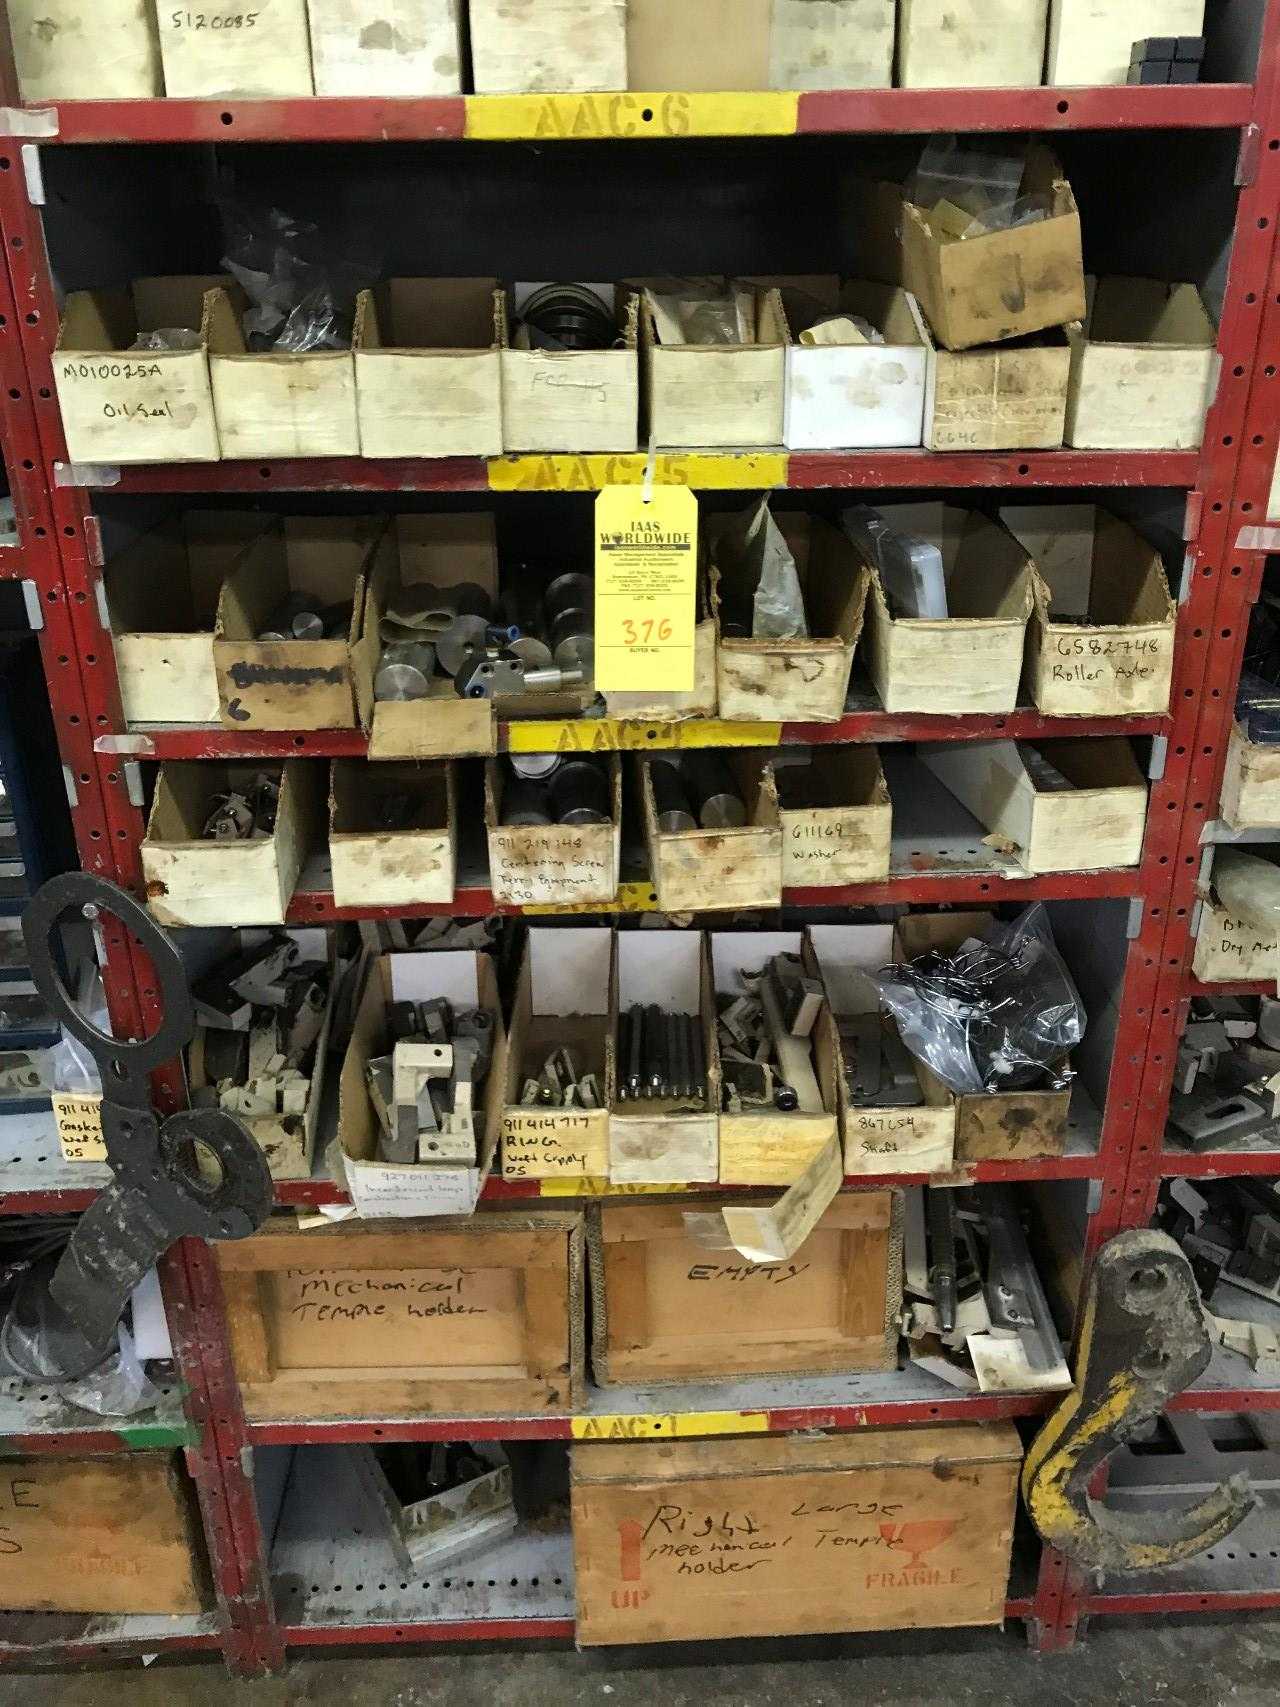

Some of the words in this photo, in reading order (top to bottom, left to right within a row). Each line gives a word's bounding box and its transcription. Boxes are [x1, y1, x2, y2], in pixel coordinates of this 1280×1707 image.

[534, 95, 637, 137] AAC
[136, 400, 174, 418] Seal
[630, 520, 661, 533] IAAS
[600, 532, 691, 544] WORLDWIDE
[621, 618, 673, 645] 376
[1052, 664, 1104, 682] Roller
[641, 1504, 760, 1541] Right
[864, 1567, 963, 1590] FRAGILE
